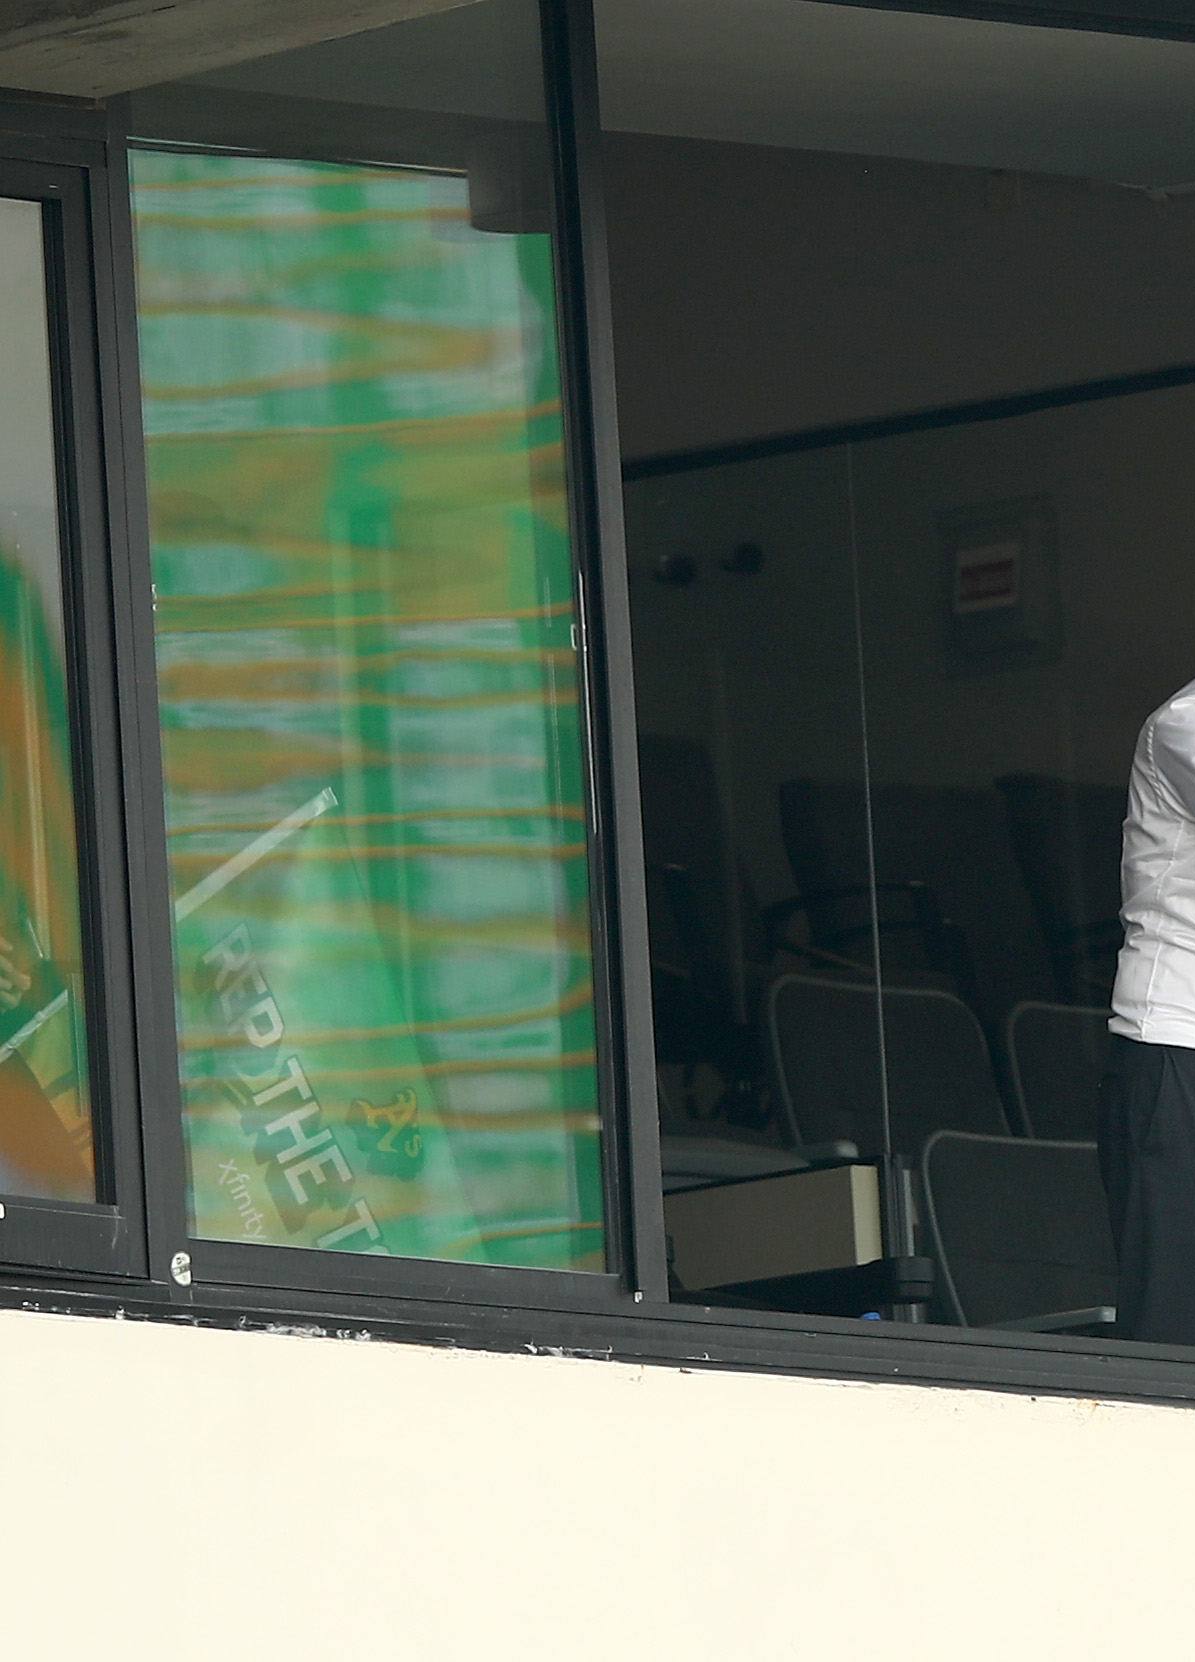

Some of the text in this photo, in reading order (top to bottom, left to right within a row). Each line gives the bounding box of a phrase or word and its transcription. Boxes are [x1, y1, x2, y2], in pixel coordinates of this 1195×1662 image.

[202, 922, 392, 1255] REP THE T
[217, 1158, 268, 1240] xfinity
